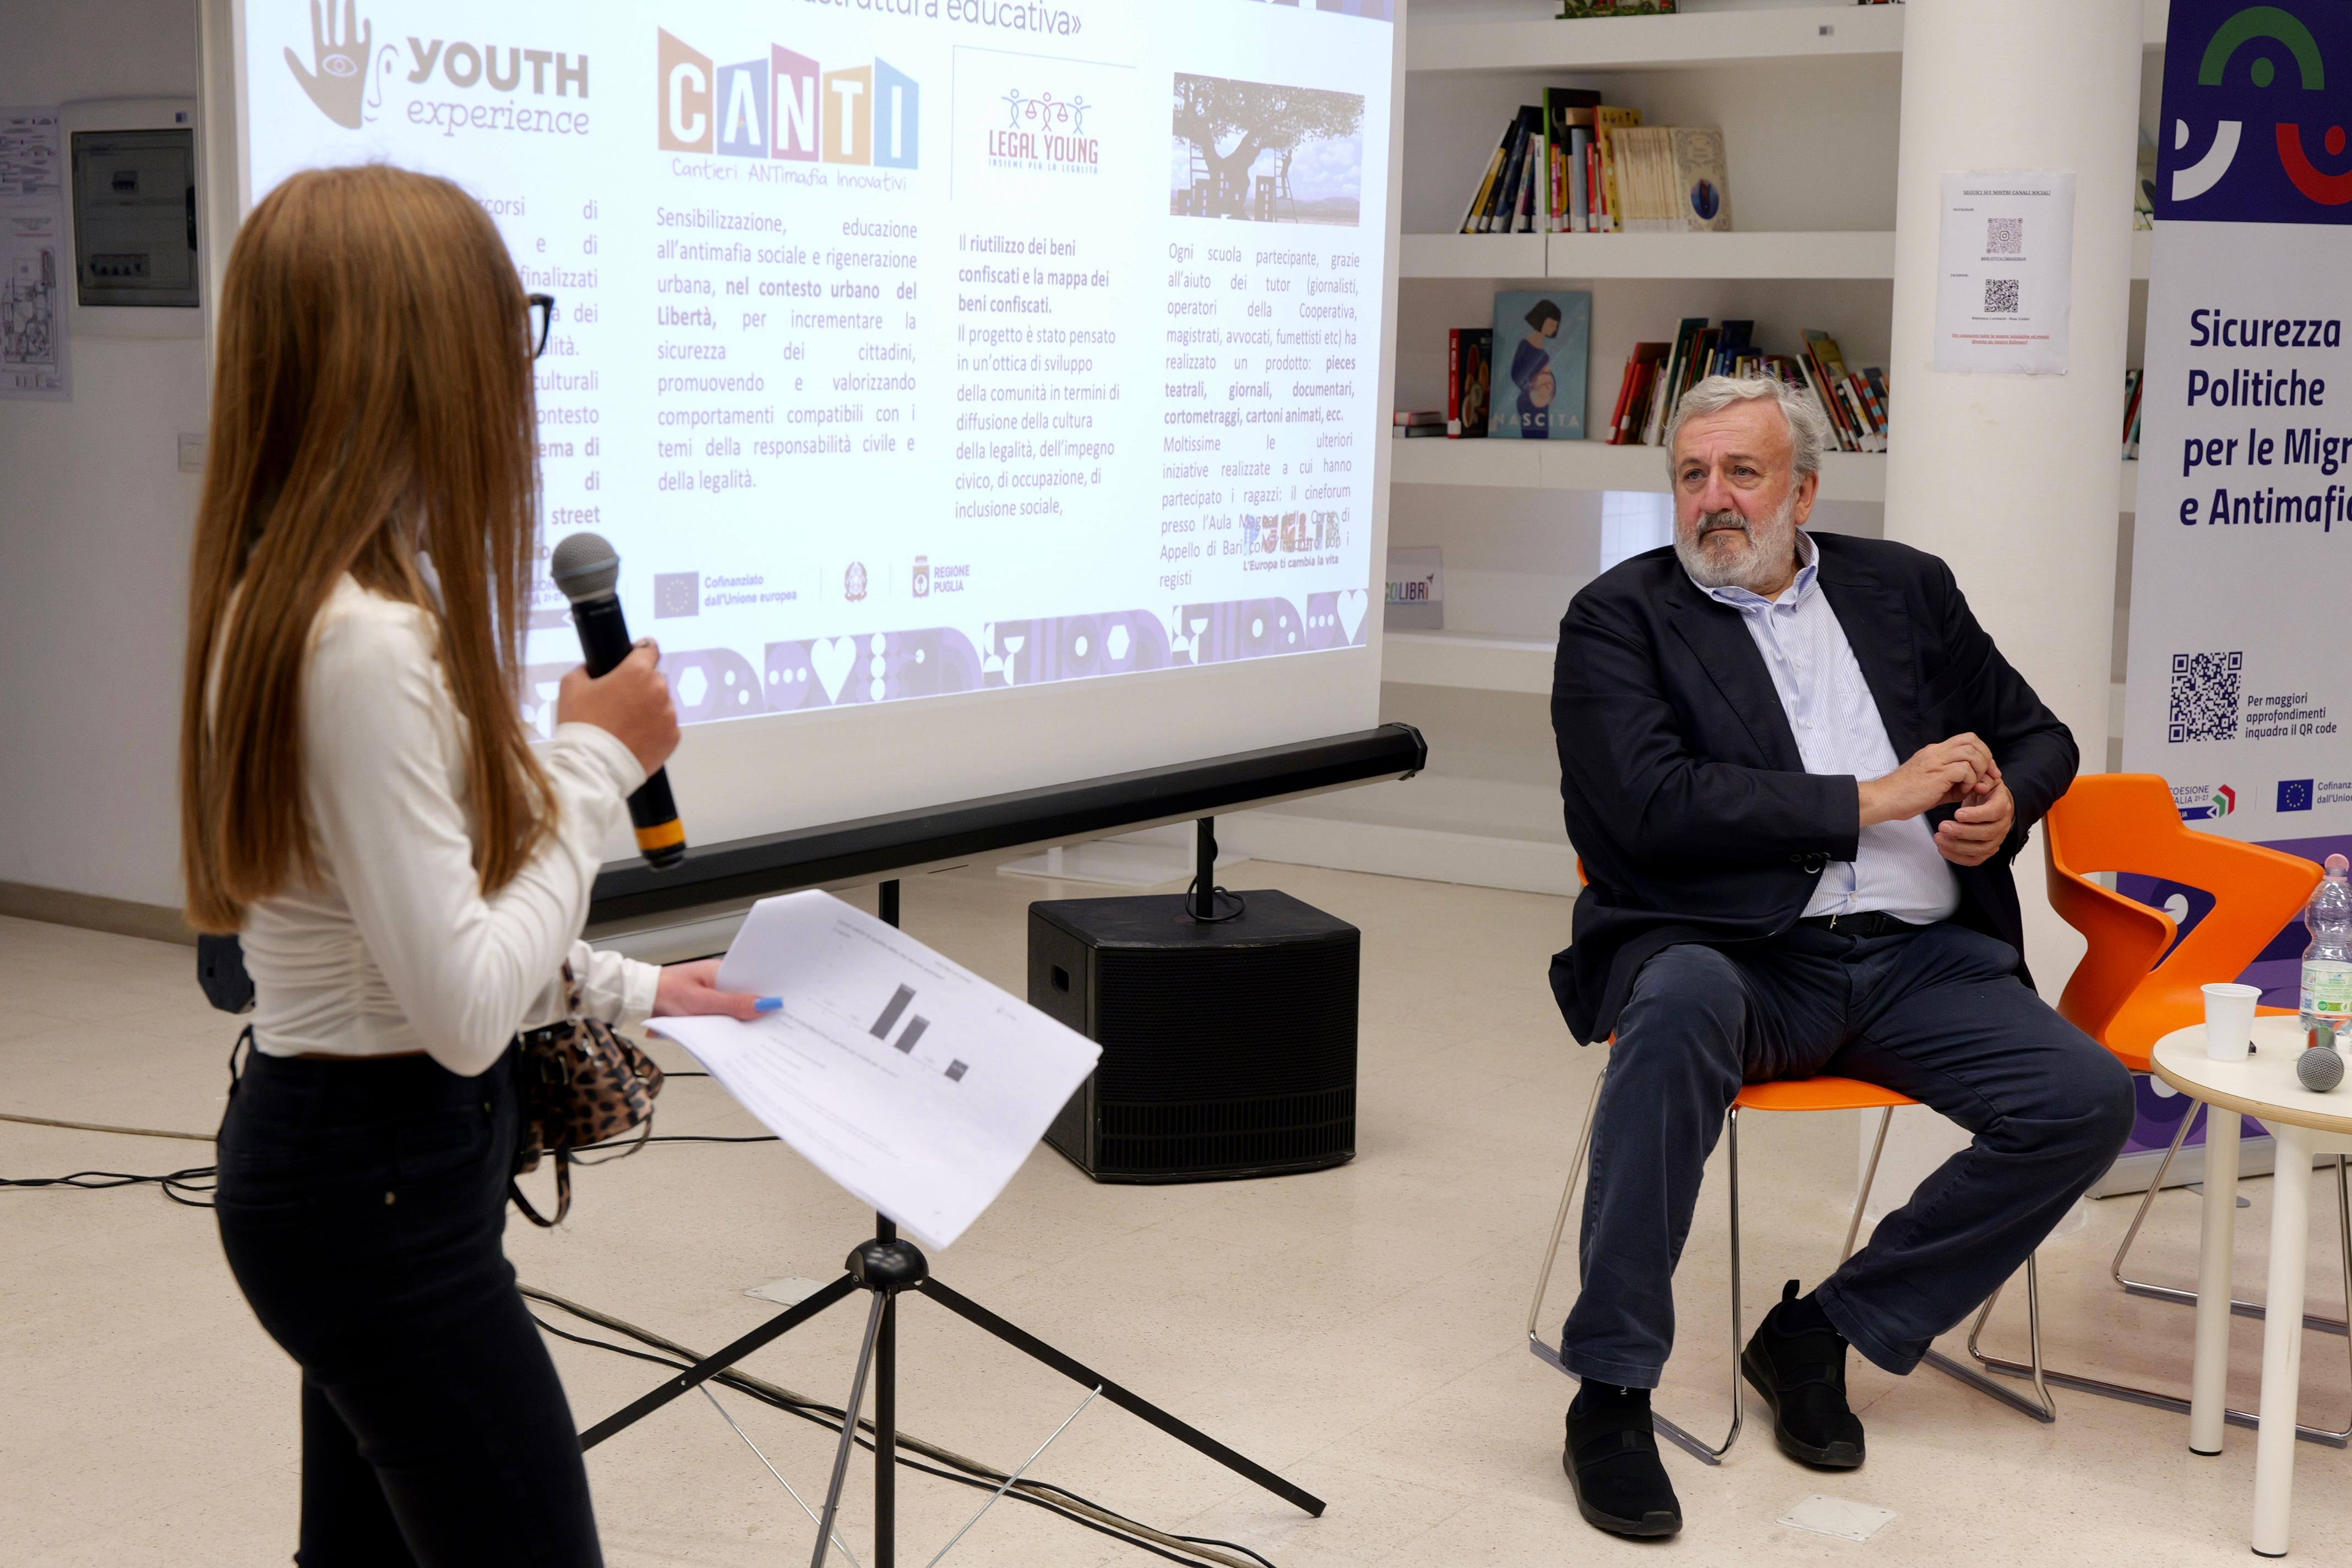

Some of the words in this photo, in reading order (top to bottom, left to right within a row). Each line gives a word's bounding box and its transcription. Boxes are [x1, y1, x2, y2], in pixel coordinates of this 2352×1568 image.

[946, 0, 1081, 35] educativa»
[406, 36, 589, 99] YOUTH
[406, 99, 589, 138] experience
[668, 62, 903, 159] CANTI
[989, 129, 1038, 160] LEGAL
[1043, 134, 1098, 165] YOUNG
[672, 157, 737, 180] Cantieri
[748, 163, 828, 187] ANTimafia
[836, 170, 906, 192] Innovativi
[656, 206, 787, 236] Sensibilizzazione,
[842, 217, 918, 239] educazione
[970, 234, 1025, 254] riutilizzo
[1028, 237, 1047, 255] dei
[1050, 238, 1076, 256] beni
[1169, 242, 1194, 263] Ogni
[1207, 246, 1242, 263] scuola
[1256, 249, 1319, 269] partecipante,
[1331, 252, 1360, 270] grazie
[757, 245, 807, 265] sociale
[826, 247, 917, 271] rigenerazione
[657, 273, 716, 298] urbana,
[726, 276, 749, 296] nel
[759, 280, 822, 298] contesto
[831, 279, 880, 299] urbano
[896, 281, 917, 300] del
[959, 264, 1020, 284] confiscati
[1047, 273, 1087, 290] mappa
[1091, 269, 1109, 287] dei
[1230, 273, 1247, 290] dei
[1266, 277, 1291, 292] tutor
[1307, 276, 1358, 297] (giornalisti,
[574, 302, 598, 324] dei
[959, 293, 987, 312] beni
[990, 295, 1052, 313] confiscati.
[1167, 300, 1217, 318] operatori
[1247, 301, 1272, 318] della
[1299, 302, 1357, 322] Cooperativa,
[658, 306, 716, 330] Libertà,
[743, 312, 767, 331] per
[791, 309, 883, 330] incrementare
[2190, 309, 2341, 347] Sicurezza
[969, 327, 1022, 347] progetto
[1037, 328, 1066, 344] stato
[1069, 329, 1116, 347] pensato
[1167, 326, 1222, 347] magistrati,
[1226, 328, 1273, 347] avvocati,
[1276, 328, 1321, 345] fumettisti
[1324, 328, 1342, 348] etc)
[657, 340, 726, 360] sicurezza
[783, 341, 804, 361] dei
[858, 342, 916, 364] cittadini,
[1166, 352, 1216, 370] realizzato
[1265, 354, 1311, 374] prodotto:
[1326, 354, 1356, 373] pieces
[1044, 354, 1093, 375] sviluppo
[658, 372, 765, 397] promuovendo
[832, 372, 916, 391] valorizzando
[957, 383, 987, 402] della
[990, 383, 1047, 401] comunità
[1064, 384, 1106, 401] termini
[1164, 380, 1207, 400] teatrali,
[1228, 381, 1272, 401] giornali,
[1292, 380, 1354, 399] documentari,
[2187, 368, 2325, 407] Politiche
[657, 405, 774, 429] comportamenti
[787, 404, 863, 428] compatibili
[876, 408, 899, 422] con
[956, 412, 1018, 431] diffusione
[1021, 412, 1049, 430] della
[1052, 411, 1093, 429] cultura
[1164, 407, 1243, 427] cortometraggi,
[1245, 407, 1283, 423] cartoni
[1285, 406, 1324, 424] animati,
[1326, 409, 1343, 422] ecc.
[1492, 413, 1580, 427] NASCITA
[657, 438, 692, 458] temi
[705, 436, 741, 457] della
[754, 434, 851, 459] responsabilità
[862, 433, 896, 453] civile
[956, 441, 986, 460] della
[989, 440, 1036, 463] legalità,
[1163, 435, 1221, 453] Moltissime
[1316, 432, 1353, 448] ulteriori
[2184, 439, 2238, 477] per
[2248, 428, 2274, 465] le
[1163, 462, 1209, 479] iniziative
[1221, 460, 1271, 477] realizzate
[1299, 458, 1313, 475] cui
[1323, 457, 1352, 473] hanno
[658, 471, 694, 492] della
[699, 469, 756, 494] legalità.
[955, 472, 994, 492] civico,
[1011, 469, 1087, 491] occupazione,
[1162, 489, 1222, 511] partecipato
[1243, 486, 1282, 507] ragazzi:
[1304, 482, 1351, 500] cineforum
[551, 505, 601, 525] street
[955, 500, 1016, 519] inclusione
[1020, 497, 1063, 516] sociale,
[2180, 498, 2198, 525] e
[1161, 519, 1196, 537] presso
[1159, 541, 1200, 563] Appello
[1223, 539, 1243, 556] Bari
[1280, 558, 1286, 568] ti
[1288, 556, 1315, 568] cambia
[1317, 554, 1324, 565] la
[1325, 554, 1339, 564] vita
[704, 574, 764, 589] Cofinanziato
[933, 564, 970, 579] REGIONE
[1159, 569, 1192, 591] registi
[759, 591, 797, 604] europea
[933, 580, 964, 594] PUGLIA
[2247, 695, 2263, 707] Per
[2266, 692, 2308, 708] maggiori
[2246, 706, 2326, 725] approfondimenti
[2245, 725, 2288, 741] inquadra
[2291, 723, 2297, 736] il
[2299, 723, 2313, 737] QR
[2315, 722, 2337, 734] code
